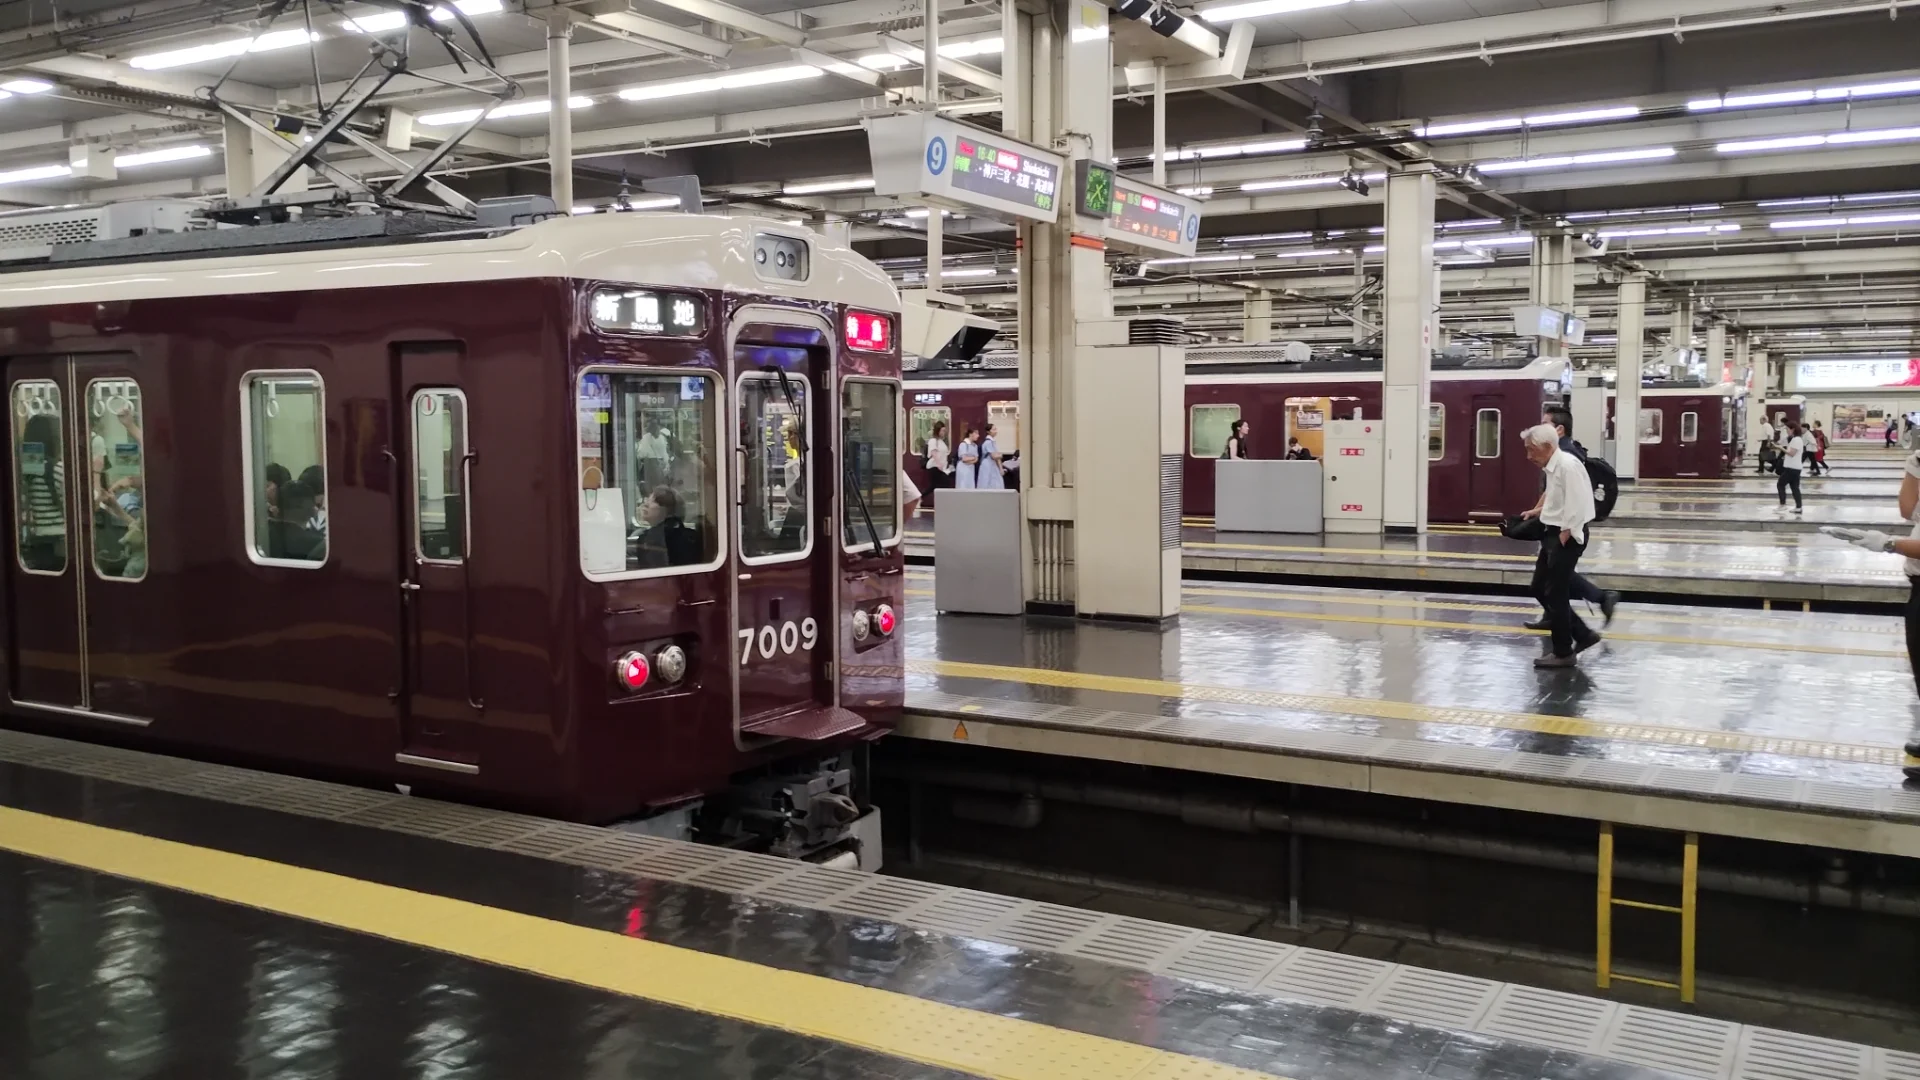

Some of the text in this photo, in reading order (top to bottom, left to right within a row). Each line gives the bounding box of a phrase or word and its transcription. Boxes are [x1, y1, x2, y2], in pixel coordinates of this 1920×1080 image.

[931, 142, 943, 170] 9
[1188, 219, 1196, 235] 8
[595, 294, 696, 326] 新開地
[738, 617, 818, 665] 7009
